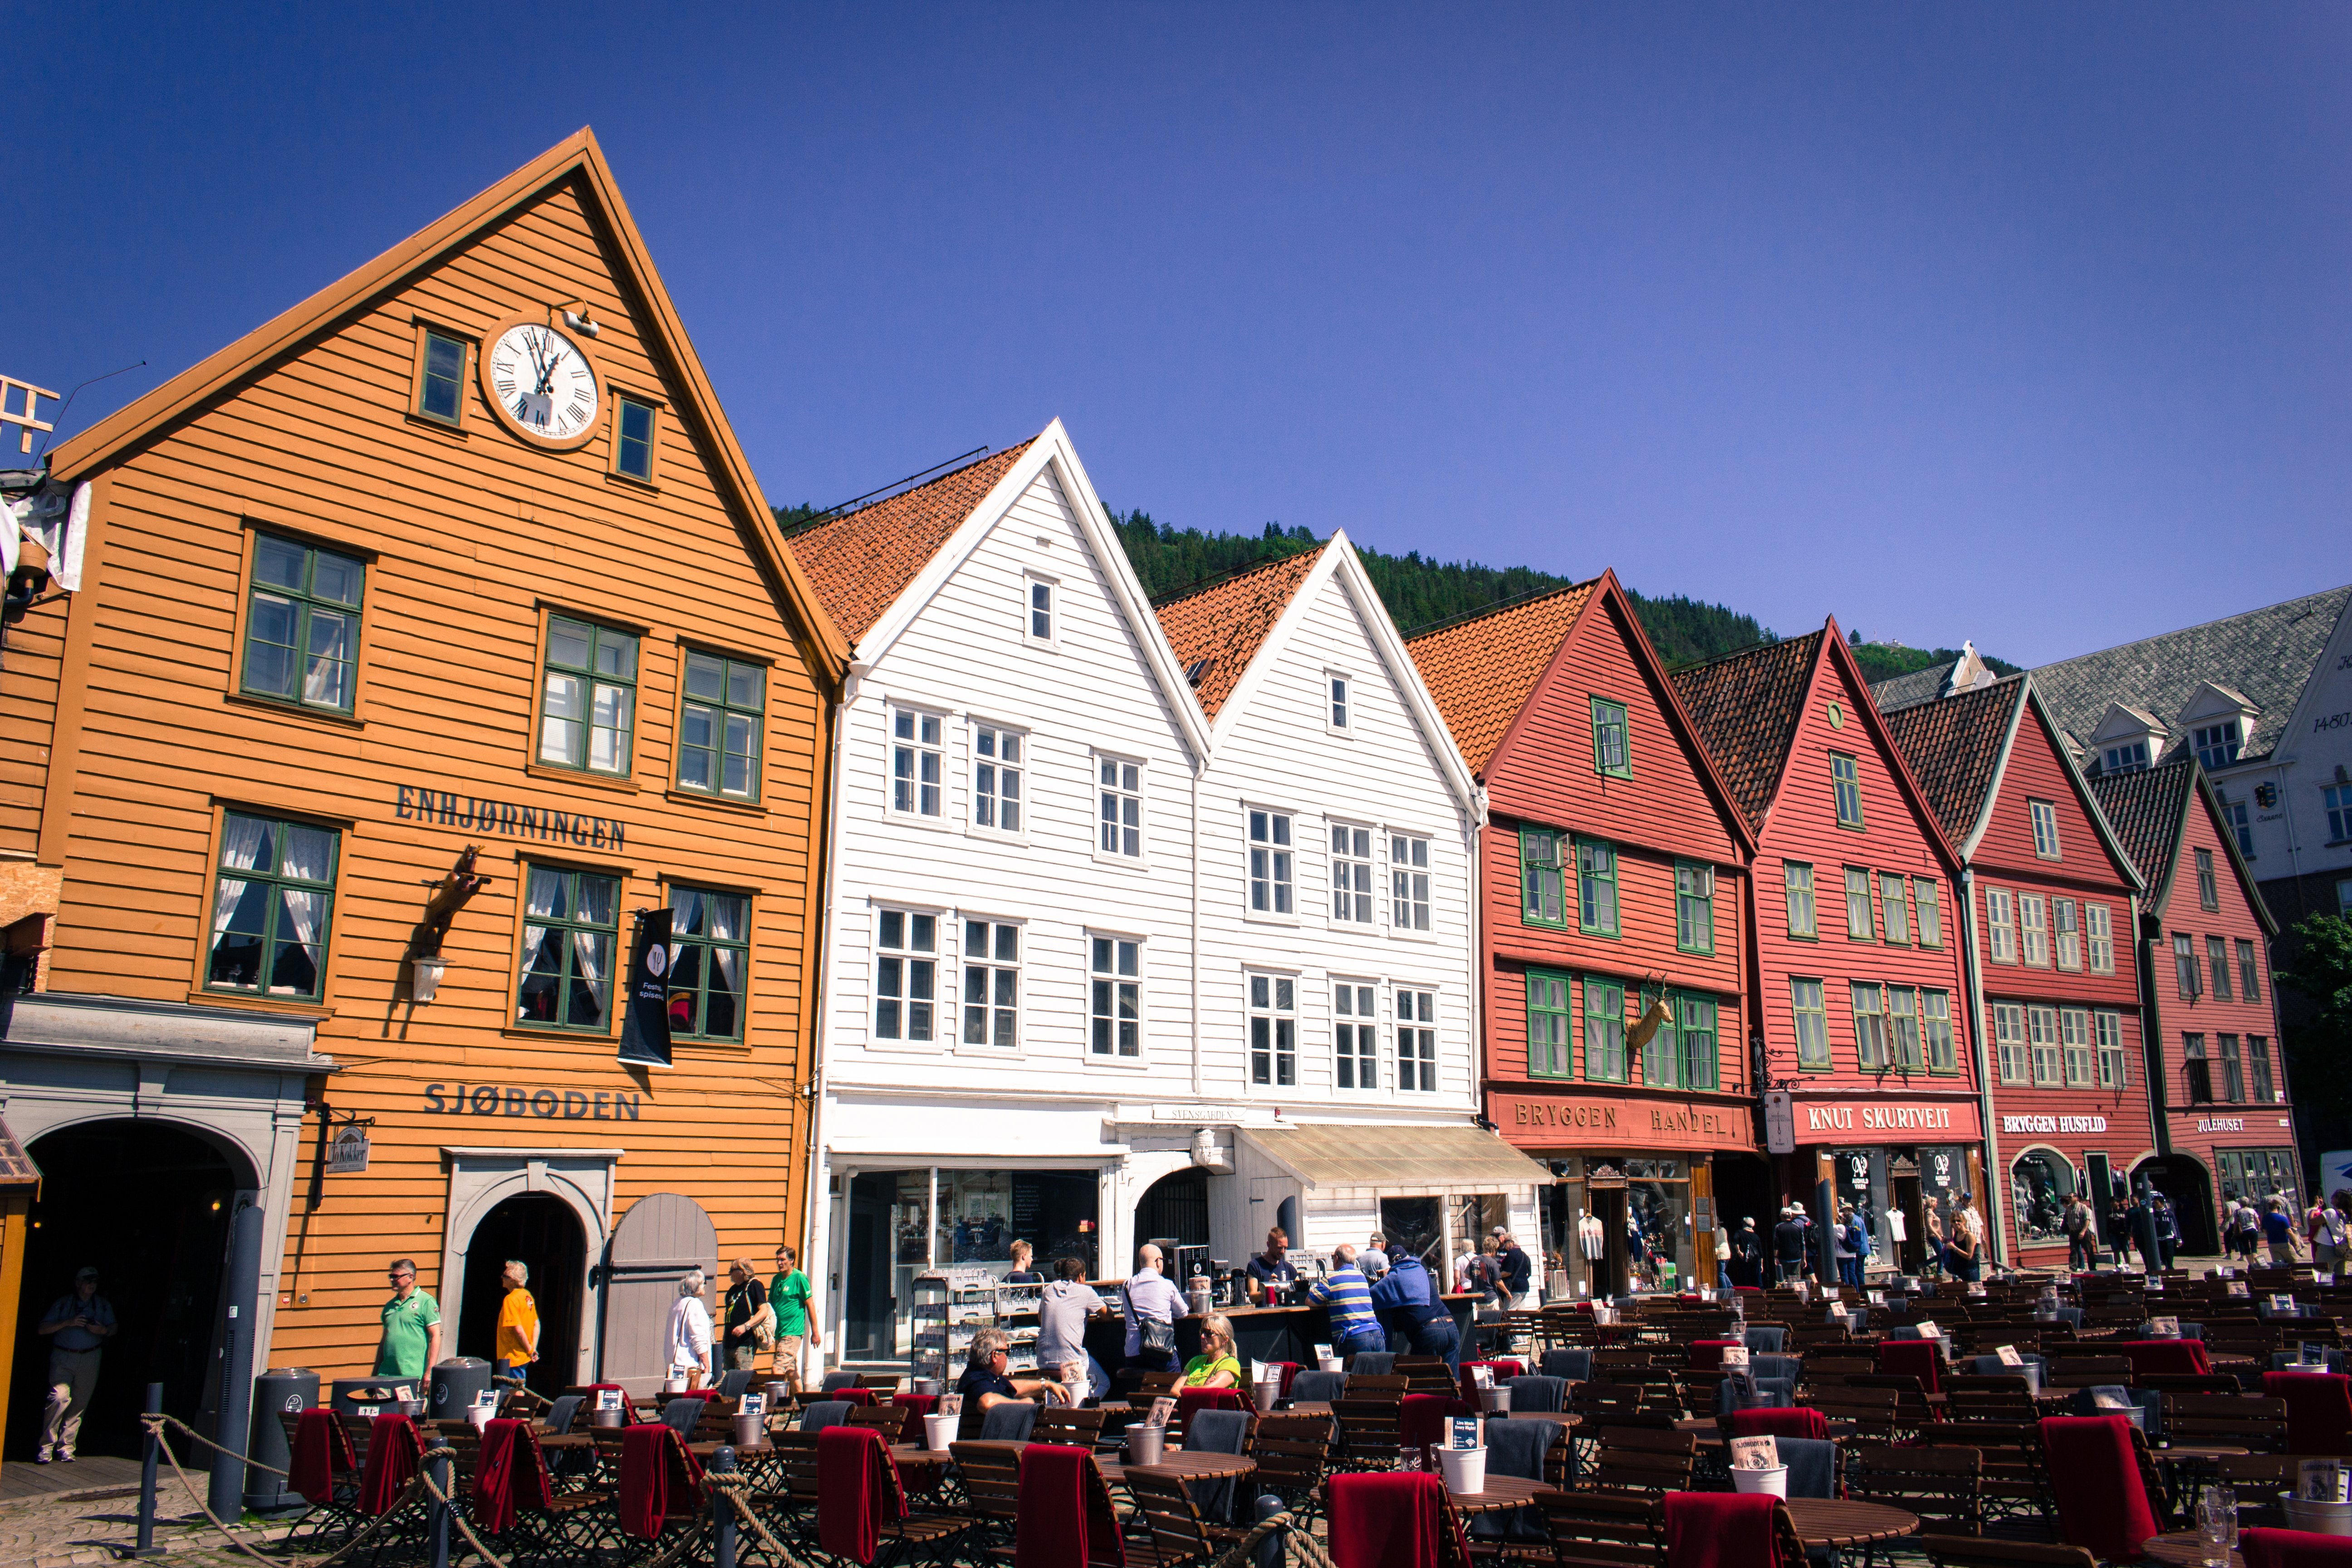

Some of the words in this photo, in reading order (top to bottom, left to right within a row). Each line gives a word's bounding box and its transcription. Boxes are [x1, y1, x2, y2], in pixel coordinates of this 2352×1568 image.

[396, 786, 625, 852] ENHJØRNINGEN
[424, 1084, 640, 1120] SJØBODEN
[1515, 1103, 1616, 1127] BRYGGEN
[1651, 1110, 1727, 1133] HANDEL
[1808, 1108, 1853, 1130] KNUT
[1862, 1107, 1950, 1129] SKURTVEIT
[2003, 1115, 2057, 1133] BRYGGEN
[2058, 1116, 2107, 1133] HUSFLID
[2197, 1118, 2243, 1132] JULEHUSET
[331, 1146, 339, 1163] To
[339, 1144, 366, 1162] Kokker
